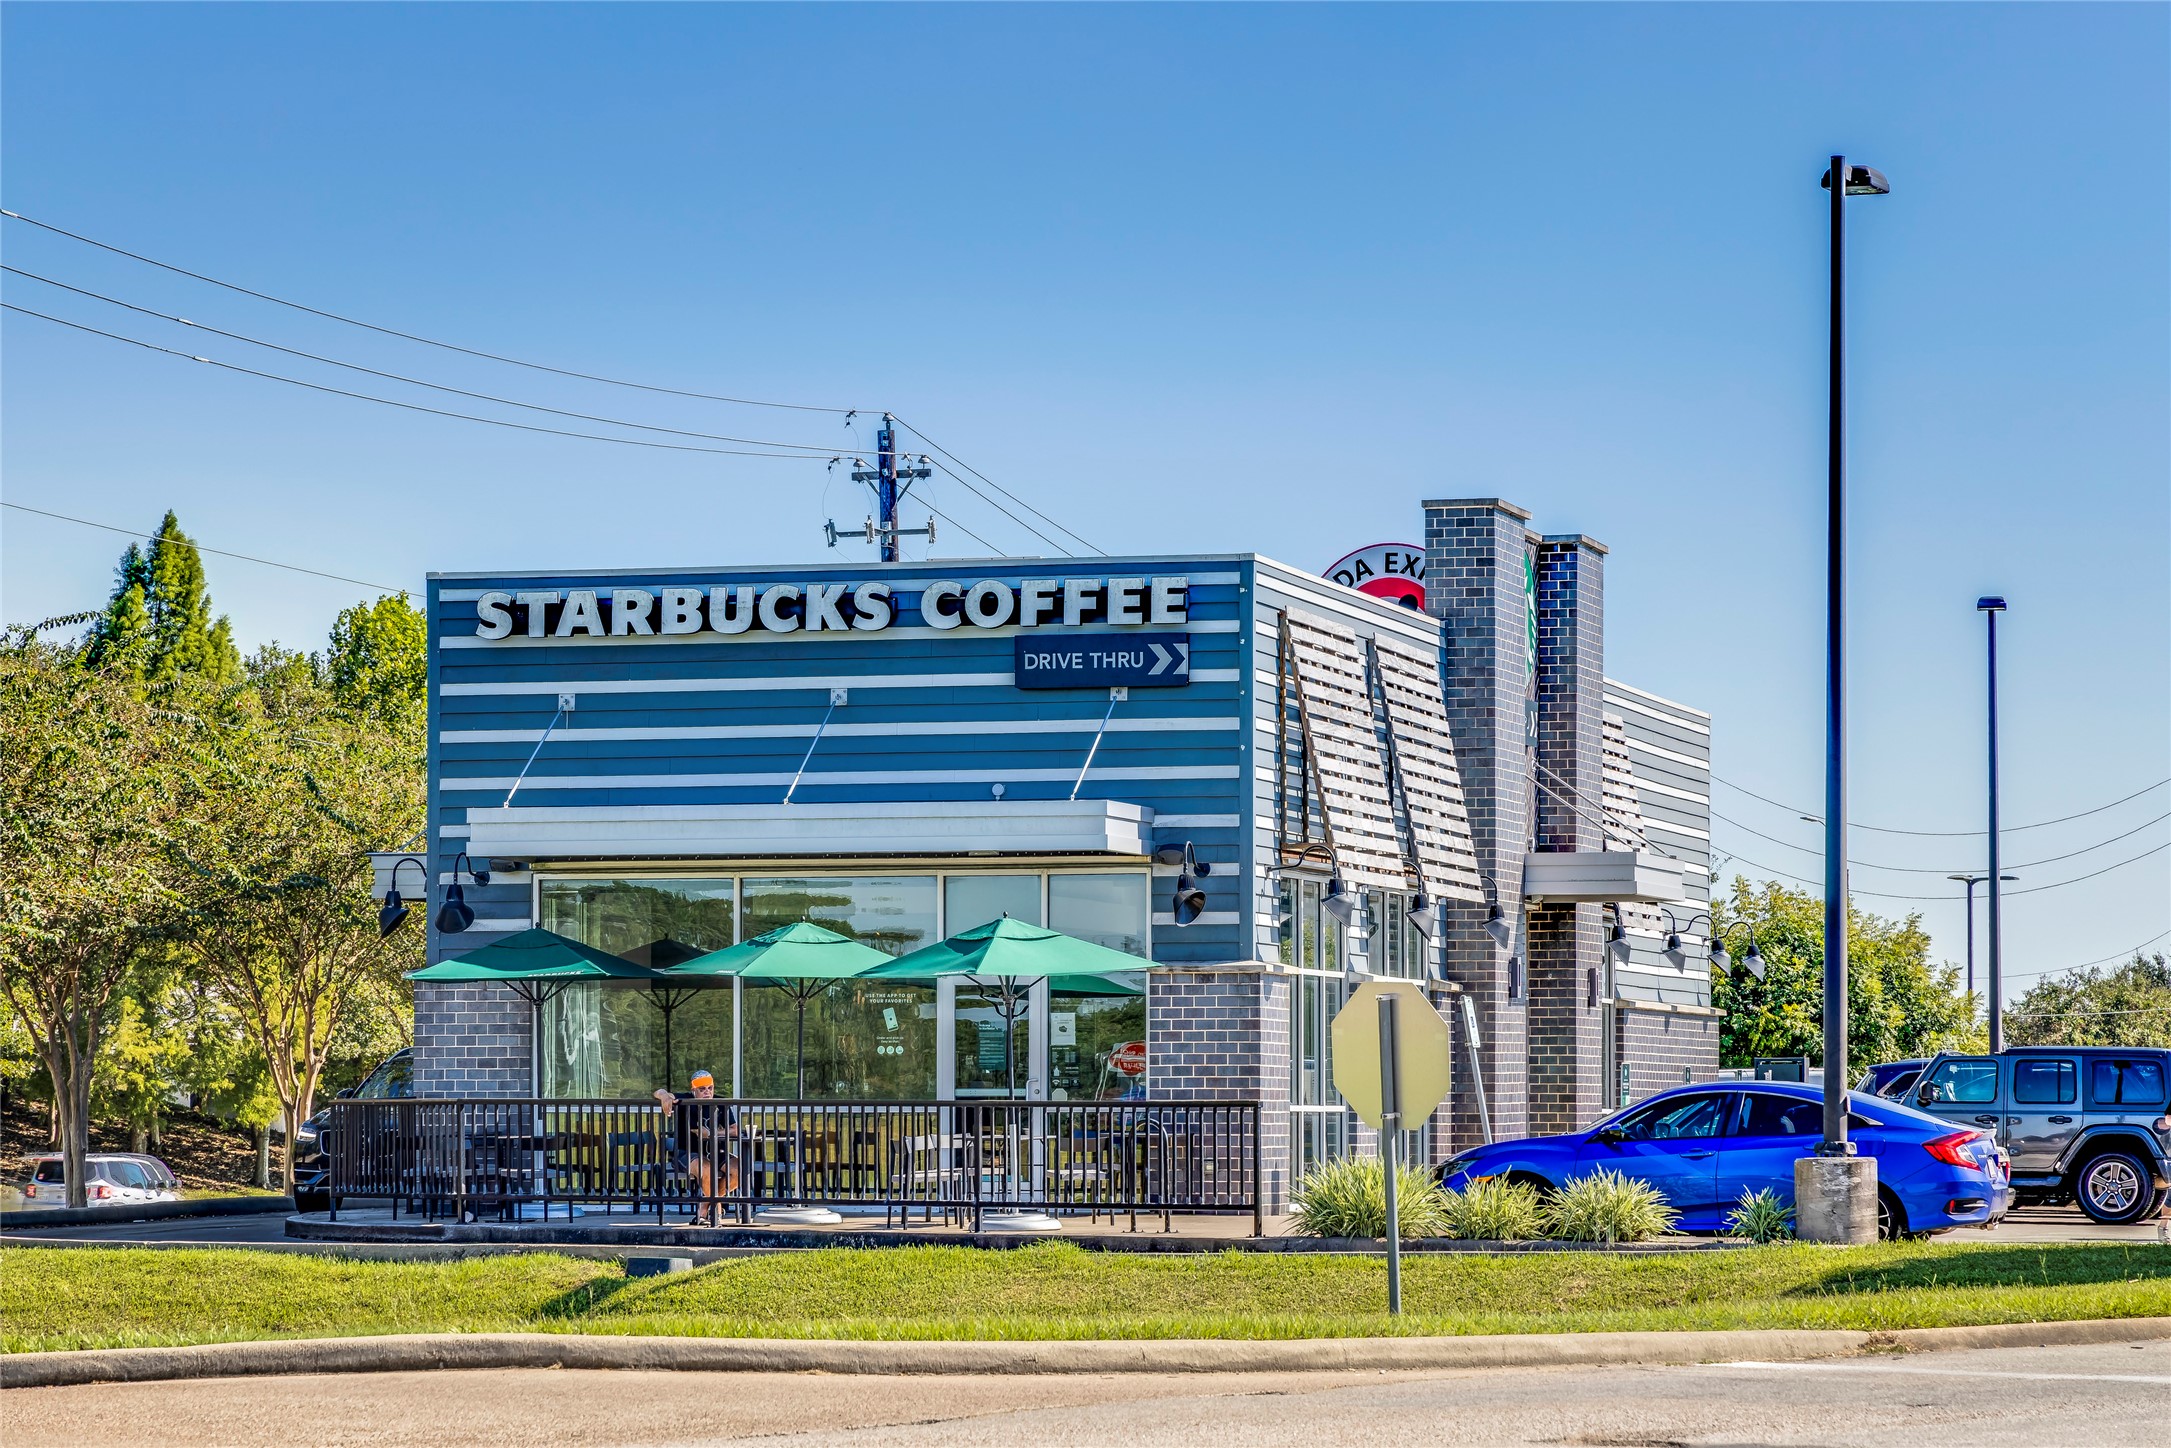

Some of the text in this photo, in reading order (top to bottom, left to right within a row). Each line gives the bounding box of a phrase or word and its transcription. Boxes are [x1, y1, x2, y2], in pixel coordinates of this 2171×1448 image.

[1384, 552, 1425, 581] EX
[475, 576, 1189, 640] STARBUCKS COFFEE
[1024, 651, 1144, 670] DRIVE THRU
